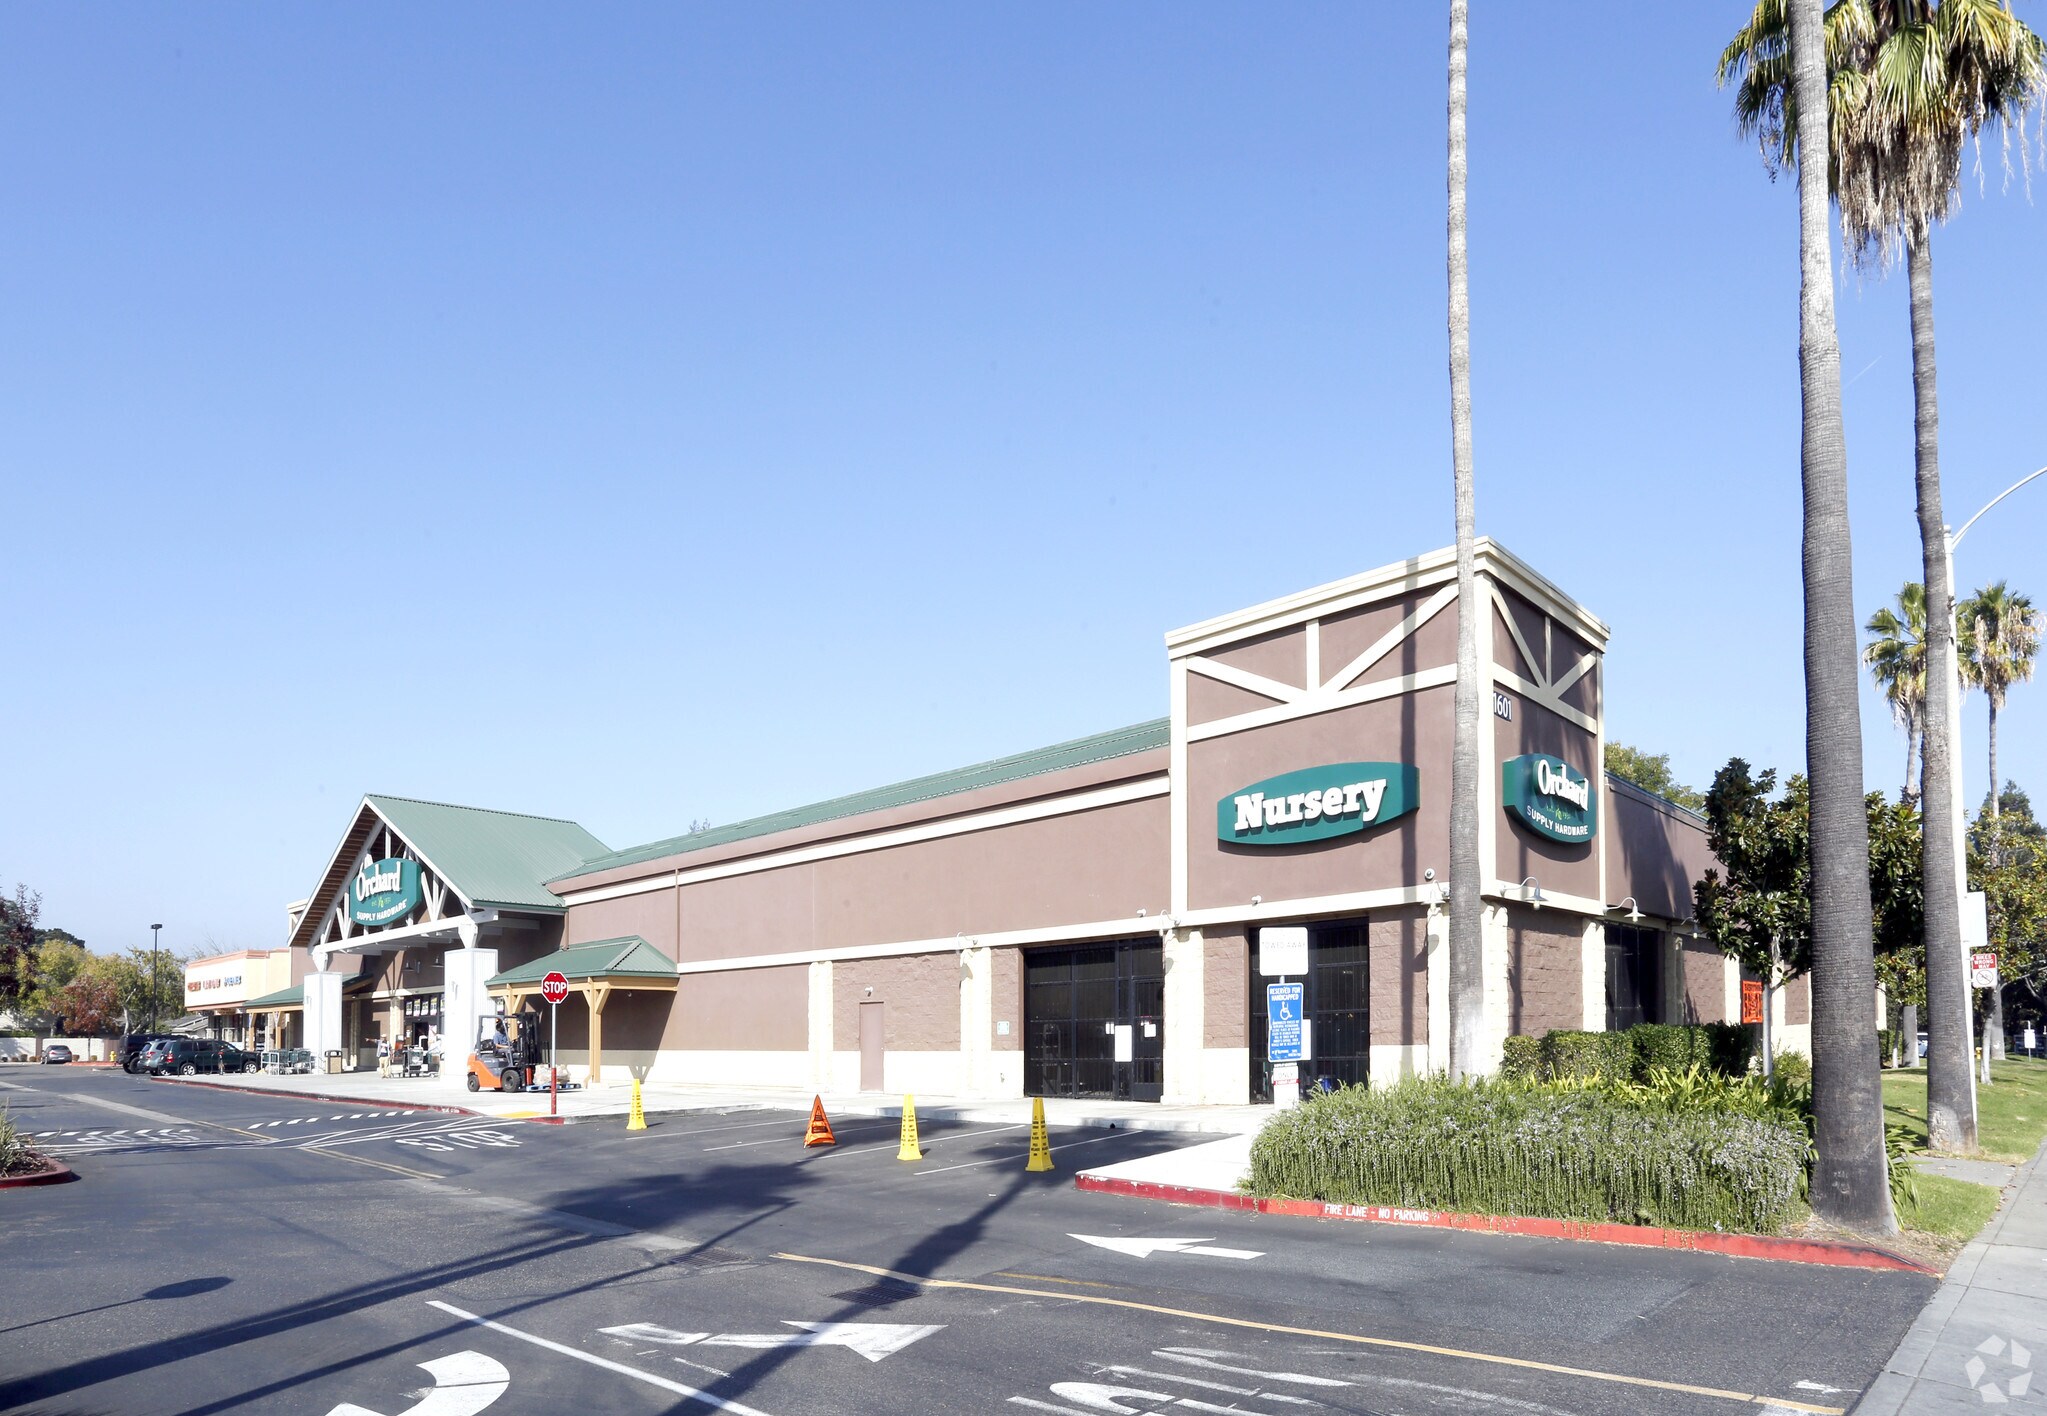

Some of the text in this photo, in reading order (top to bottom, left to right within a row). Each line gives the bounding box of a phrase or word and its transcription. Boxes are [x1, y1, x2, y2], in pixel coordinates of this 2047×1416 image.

[1493, 692, 1512, 720] 1601
[1538, 759, 1589, 811] Orchard
[1234, 778, 1387, 831] Nursery
[1526, 805, 1553, 830] SUPPLY
[1554, 822, 1589, 836] HARDWARE
[356, 861, 401, 901] Orchard
[356, 911, 376, 921] SUPPLY
[376, 900, 407, 920] HARDWARE
[543, 982, 566, 993] STOP
[1269, 986, 1301, 995] RESERVED FOR
[1271, 993, 1299, 1001] HANDICAPPED
[395, 1130, 523, 1152] STOP
[1324, 1203, 1343, 1216] FIRE
[1345, 1205, 1368, 1217] LANE
[1378, 1207, 1391, 1219] NO
[1393, 1208, 1429, 1222] PARKING
